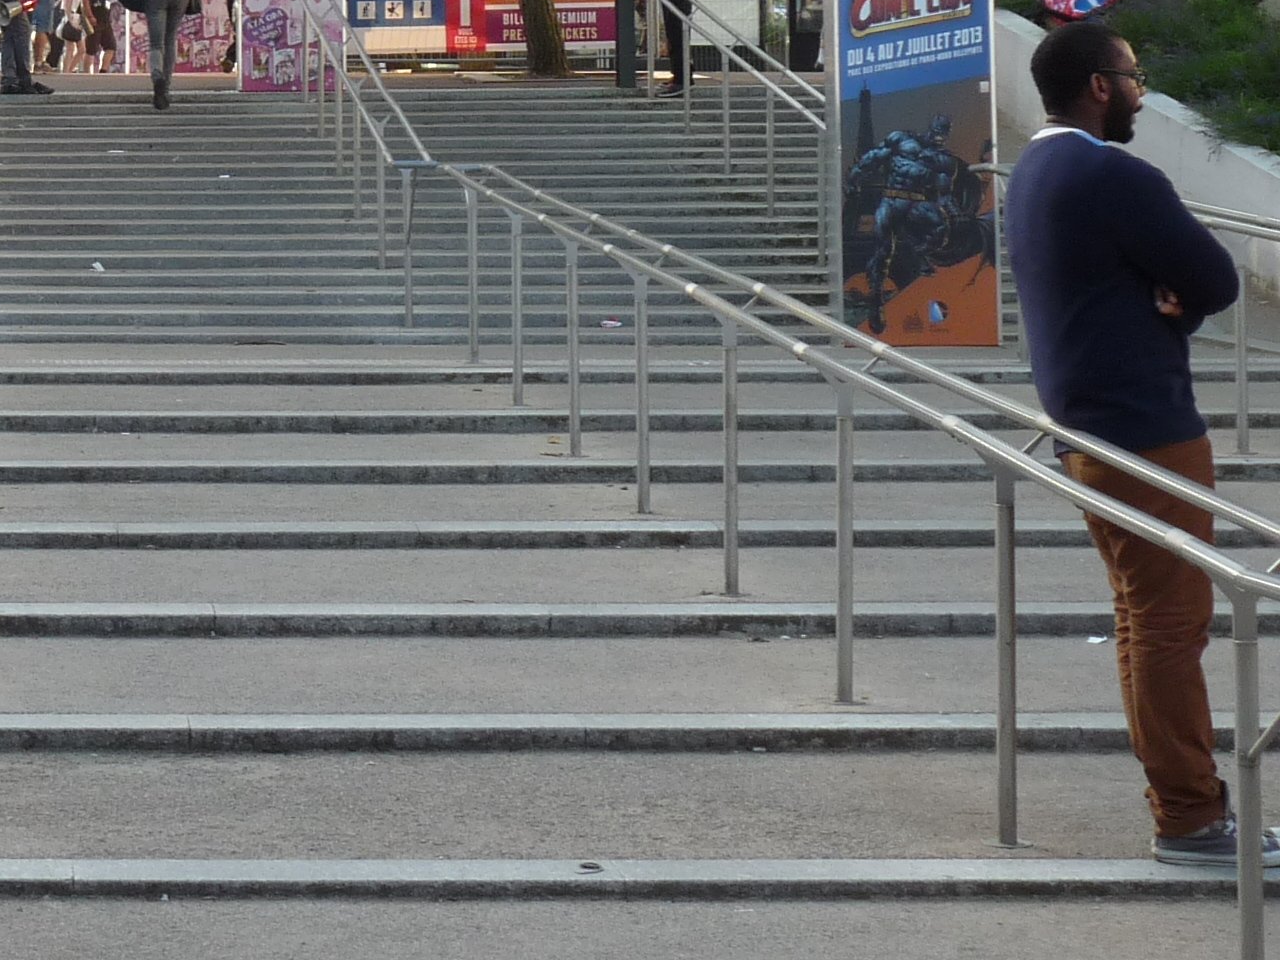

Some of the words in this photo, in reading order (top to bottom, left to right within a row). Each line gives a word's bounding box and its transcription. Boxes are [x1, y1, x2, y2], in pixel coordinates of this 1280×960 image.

[561, 27, 598, 40] ICKETS
[847, 48, 864, 67] DU
[866, 46, 875, 63] 4
[878, 43, 894, 61] AU
[896, 40, 904, 57] 7
[905, 32, 952, 56] JUILLET
[953, 26, 983, 48] 2013
